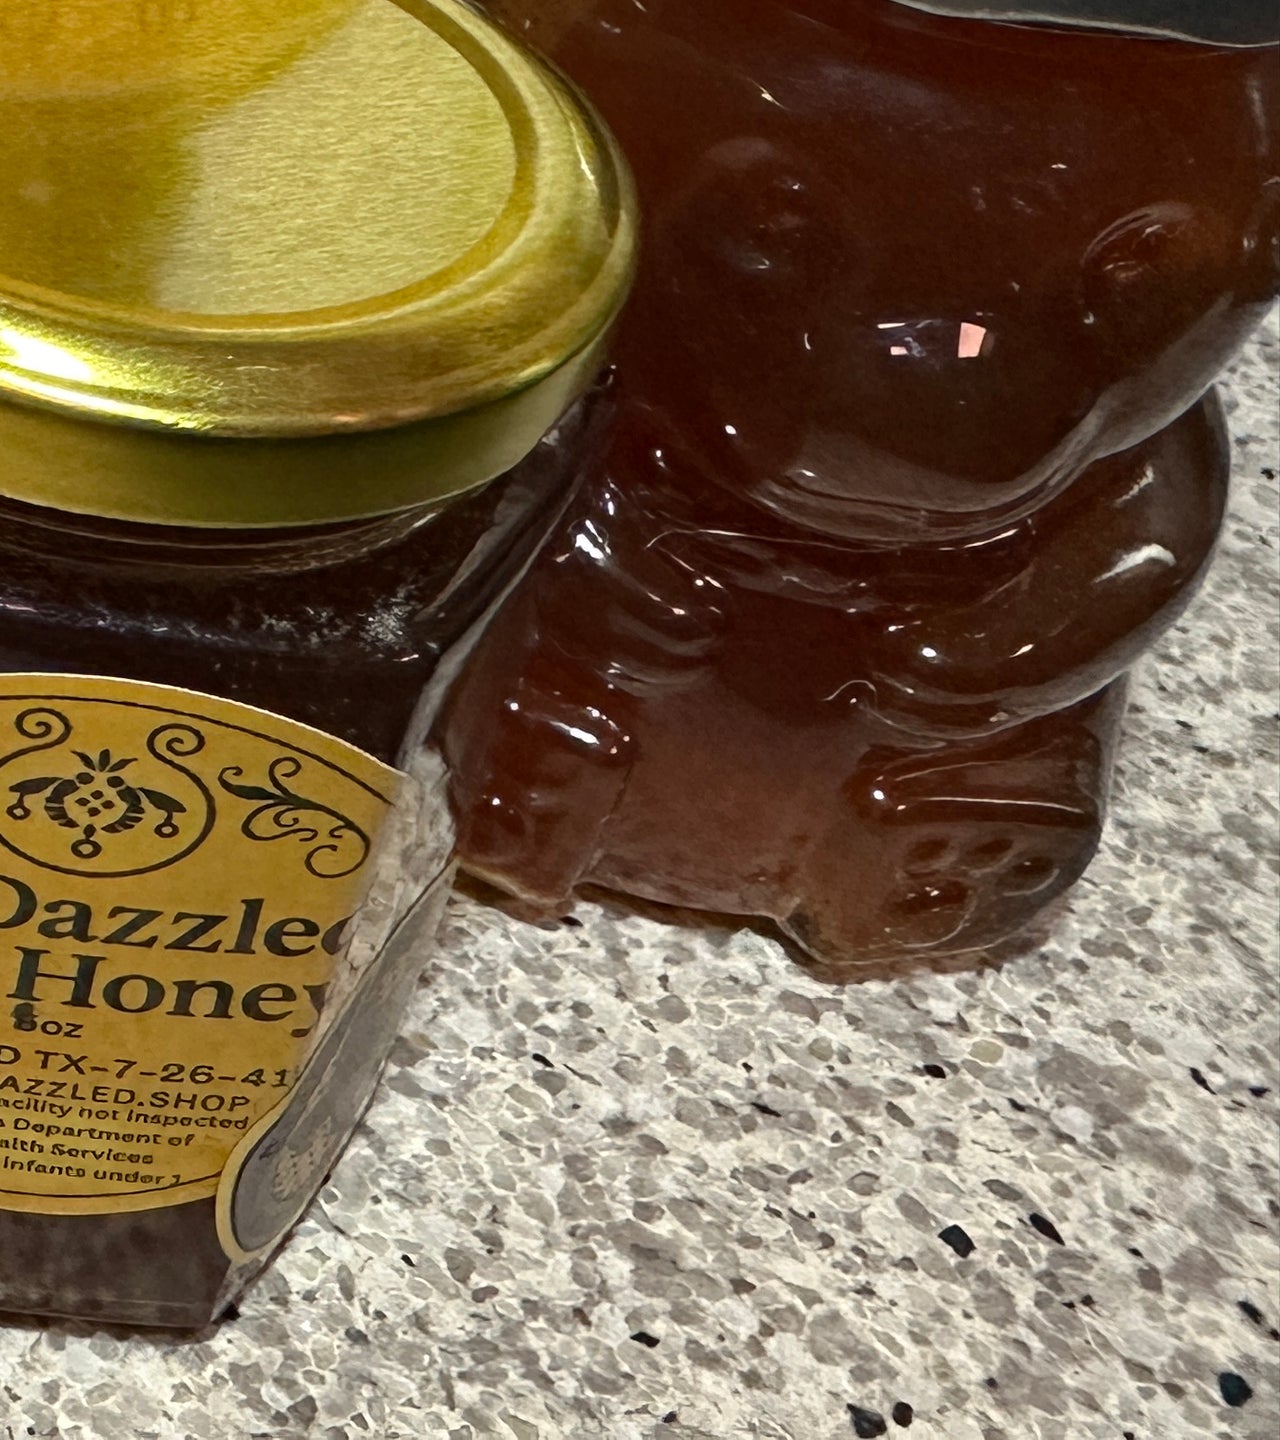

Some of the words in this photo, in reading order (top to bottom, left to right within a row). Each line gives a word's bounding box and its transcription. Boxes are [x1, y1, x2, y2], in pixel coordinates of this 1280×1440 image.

[13, 1117, 161, 1144] Department
[167, 1133, 195, 1147] of
[79, 1107, 120, 1122] not
[126, 1109, 249, 1130] inspected
[3, 1157, 85, 1178] infants
[93, 1163, 171, 1186] under
